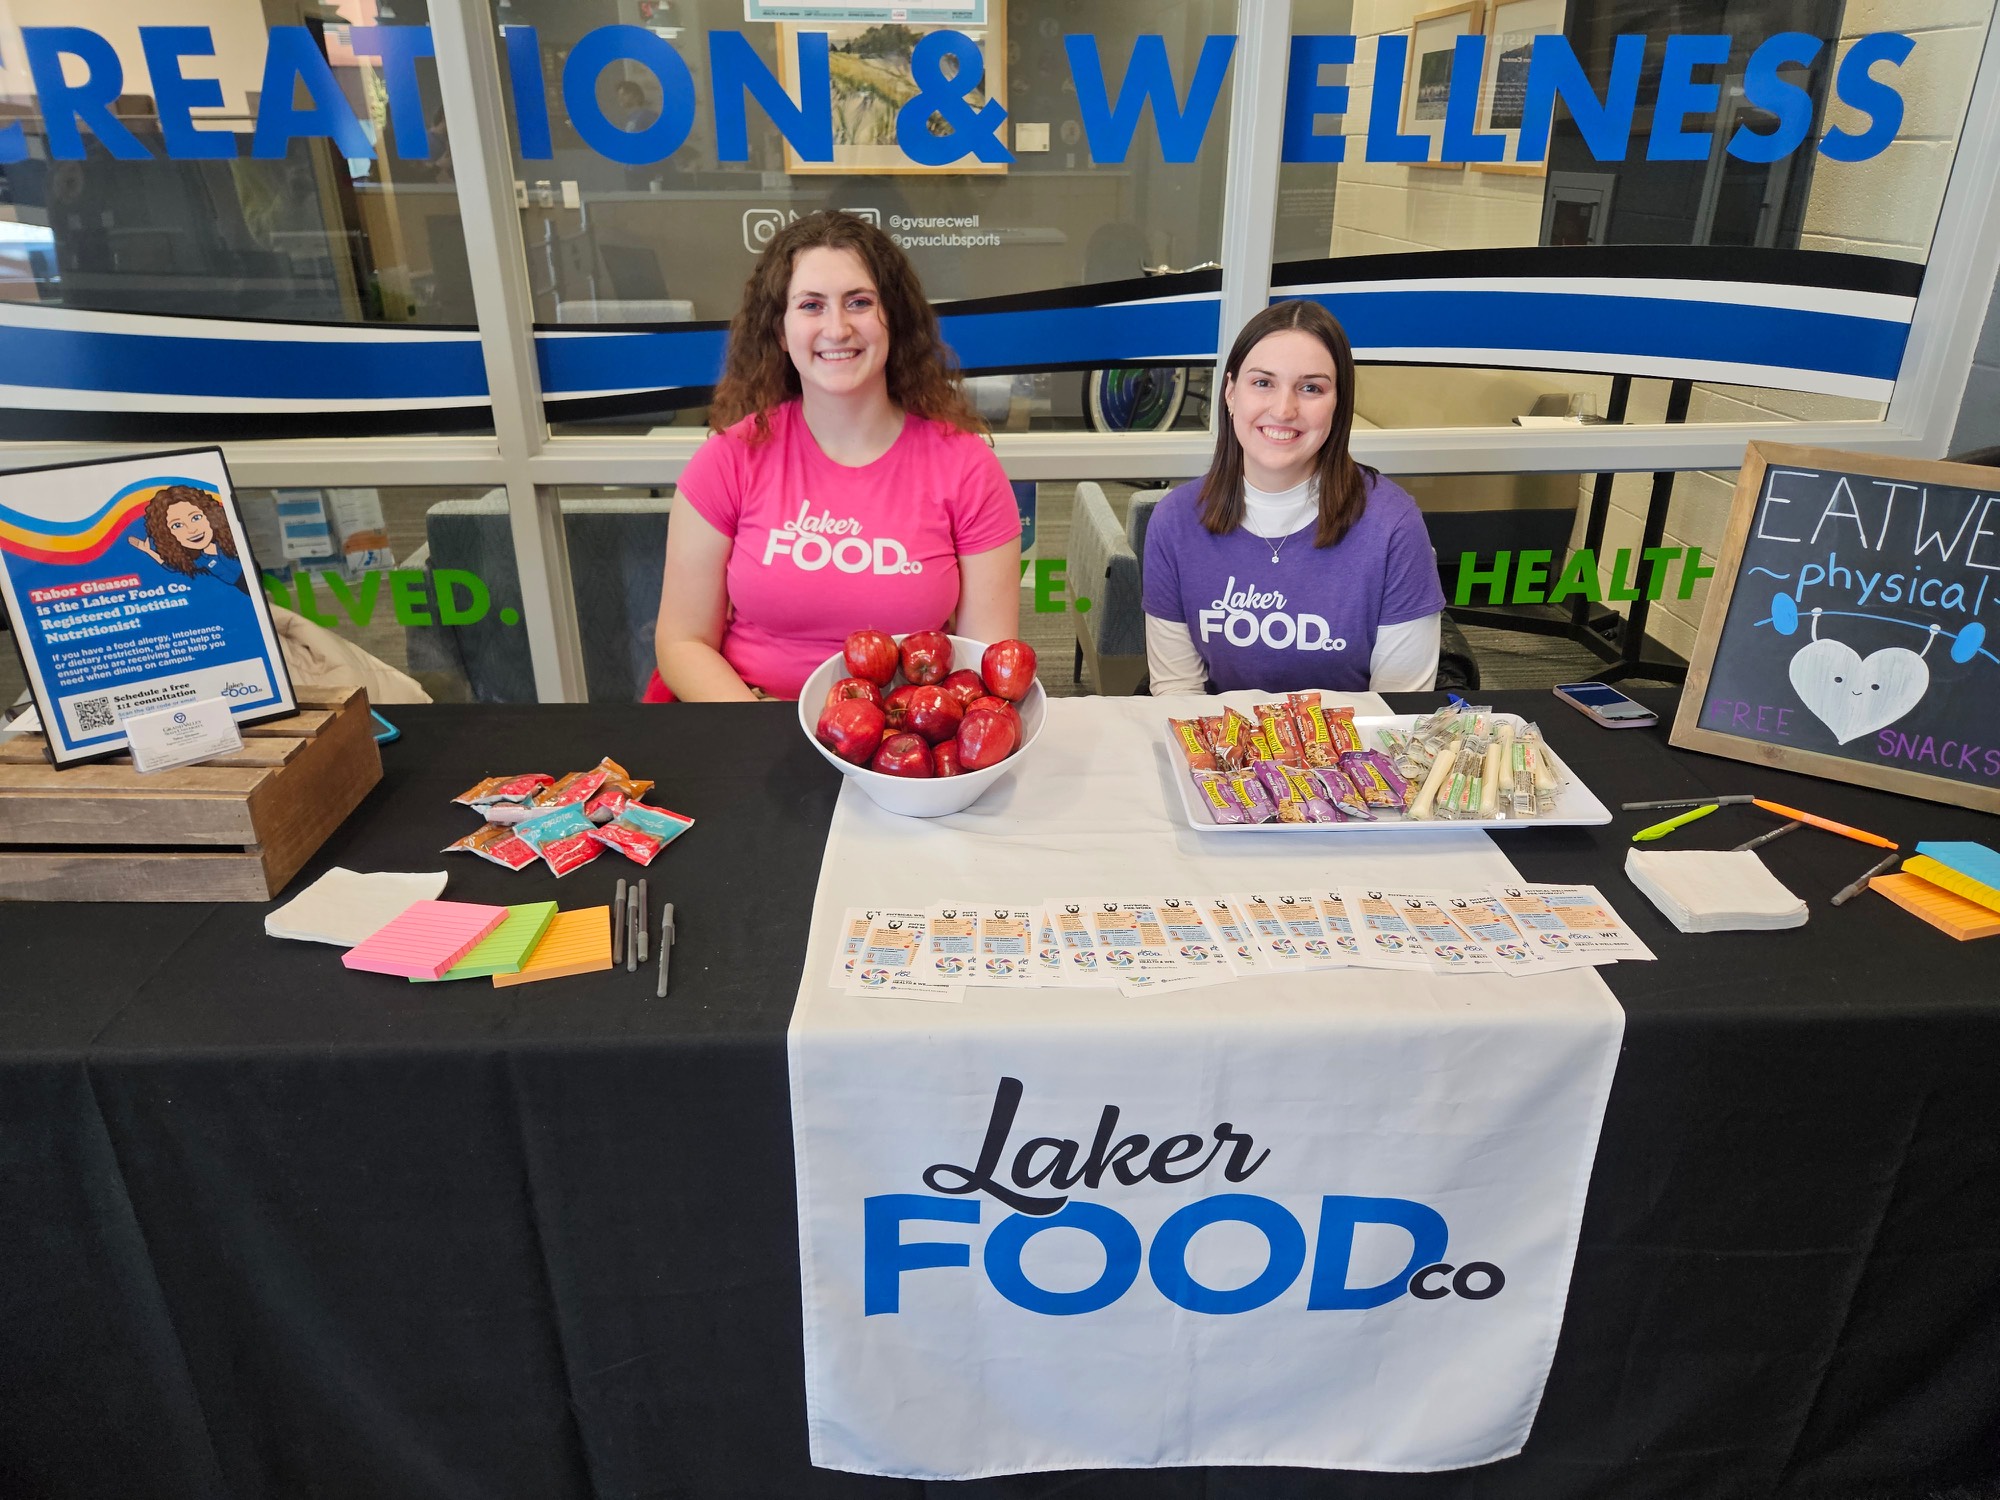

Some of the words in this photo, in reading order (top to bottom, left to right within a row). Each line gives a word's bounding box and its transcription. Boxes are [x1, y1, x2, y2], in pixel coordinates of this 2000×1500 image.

[0, 24, 833, 165] REATION
[897, 29, 1016, 166] &
[1064, 31, 1917, 163] WELLNESS
[889, 214, 979, 231] @gvsurecwell
[891, 233, 1000, 249] @gvsuclubsports
[783, 499, 863, 539] Laker
[762, 528, 908, 575] FOOD
[30, 585, 78, 603] Tabor
[80, 576, 140, 594] Gleason
[1455, 546, 1717, 606] HEALTH
[36, 604, 51, 616] is
[52, 601, 80, 614] the
[82, 592, 126, 609] Laker
[128, 586, 166, 601] Food
[167, 582, 192, 594] Co.
[40, 606, 121, 630] Registered
[123, 596, 189, 615] Dietitian
[1211, 575, 1287, 616] Laker
[45, 618, 142, 645] Nutritionist!
[52, 653, 60, 662] If
[62, 650, 80, 664] you
[82, 646, 104, 657] have
[113, 640, 136, 650] food
[137, 632, 171, 649] allergy,
[172, 624, 224, 639] intolerance,
[1199, 609, 1331, 651] FOOD
[54, 661, 66, 670] or
[67, 655, 101, 670] dietary
[103, 646, 154, 662] restriction,
[155, 641, 171, 651] she
[172, 640, 188, 648] can
[190, 634, 209, 646] help
[57, 667, 89, 678] ensure
[91, 664, 109, 677] you
[110, 660, 126, 668] are
[127, 650, 170, 666] receiving
[171, 647, 186, 657] the
[187, 642, 207, 655] help
[209, 640, 226, 652] you
[59, 676, 85, 686] need
[86, 671, 112, 682] when
[113, 664, 143, 677] dining
[144, 662, 157, 670] on
[159, 656, 196, 670] campus.
[113, 689, 160, 702] Schedule
[170, 683, 190, 691] free
[116, 703, 131, 711] 1:1
[134, 689, 197, 707] consultation
[1711, 699, 1794, 736] FREE
[1877, 729, 2000, 776] SNACKS
[922, 1076, 1272, 1216] Laker
[864, 1192, 1450, 1317] FOOD
